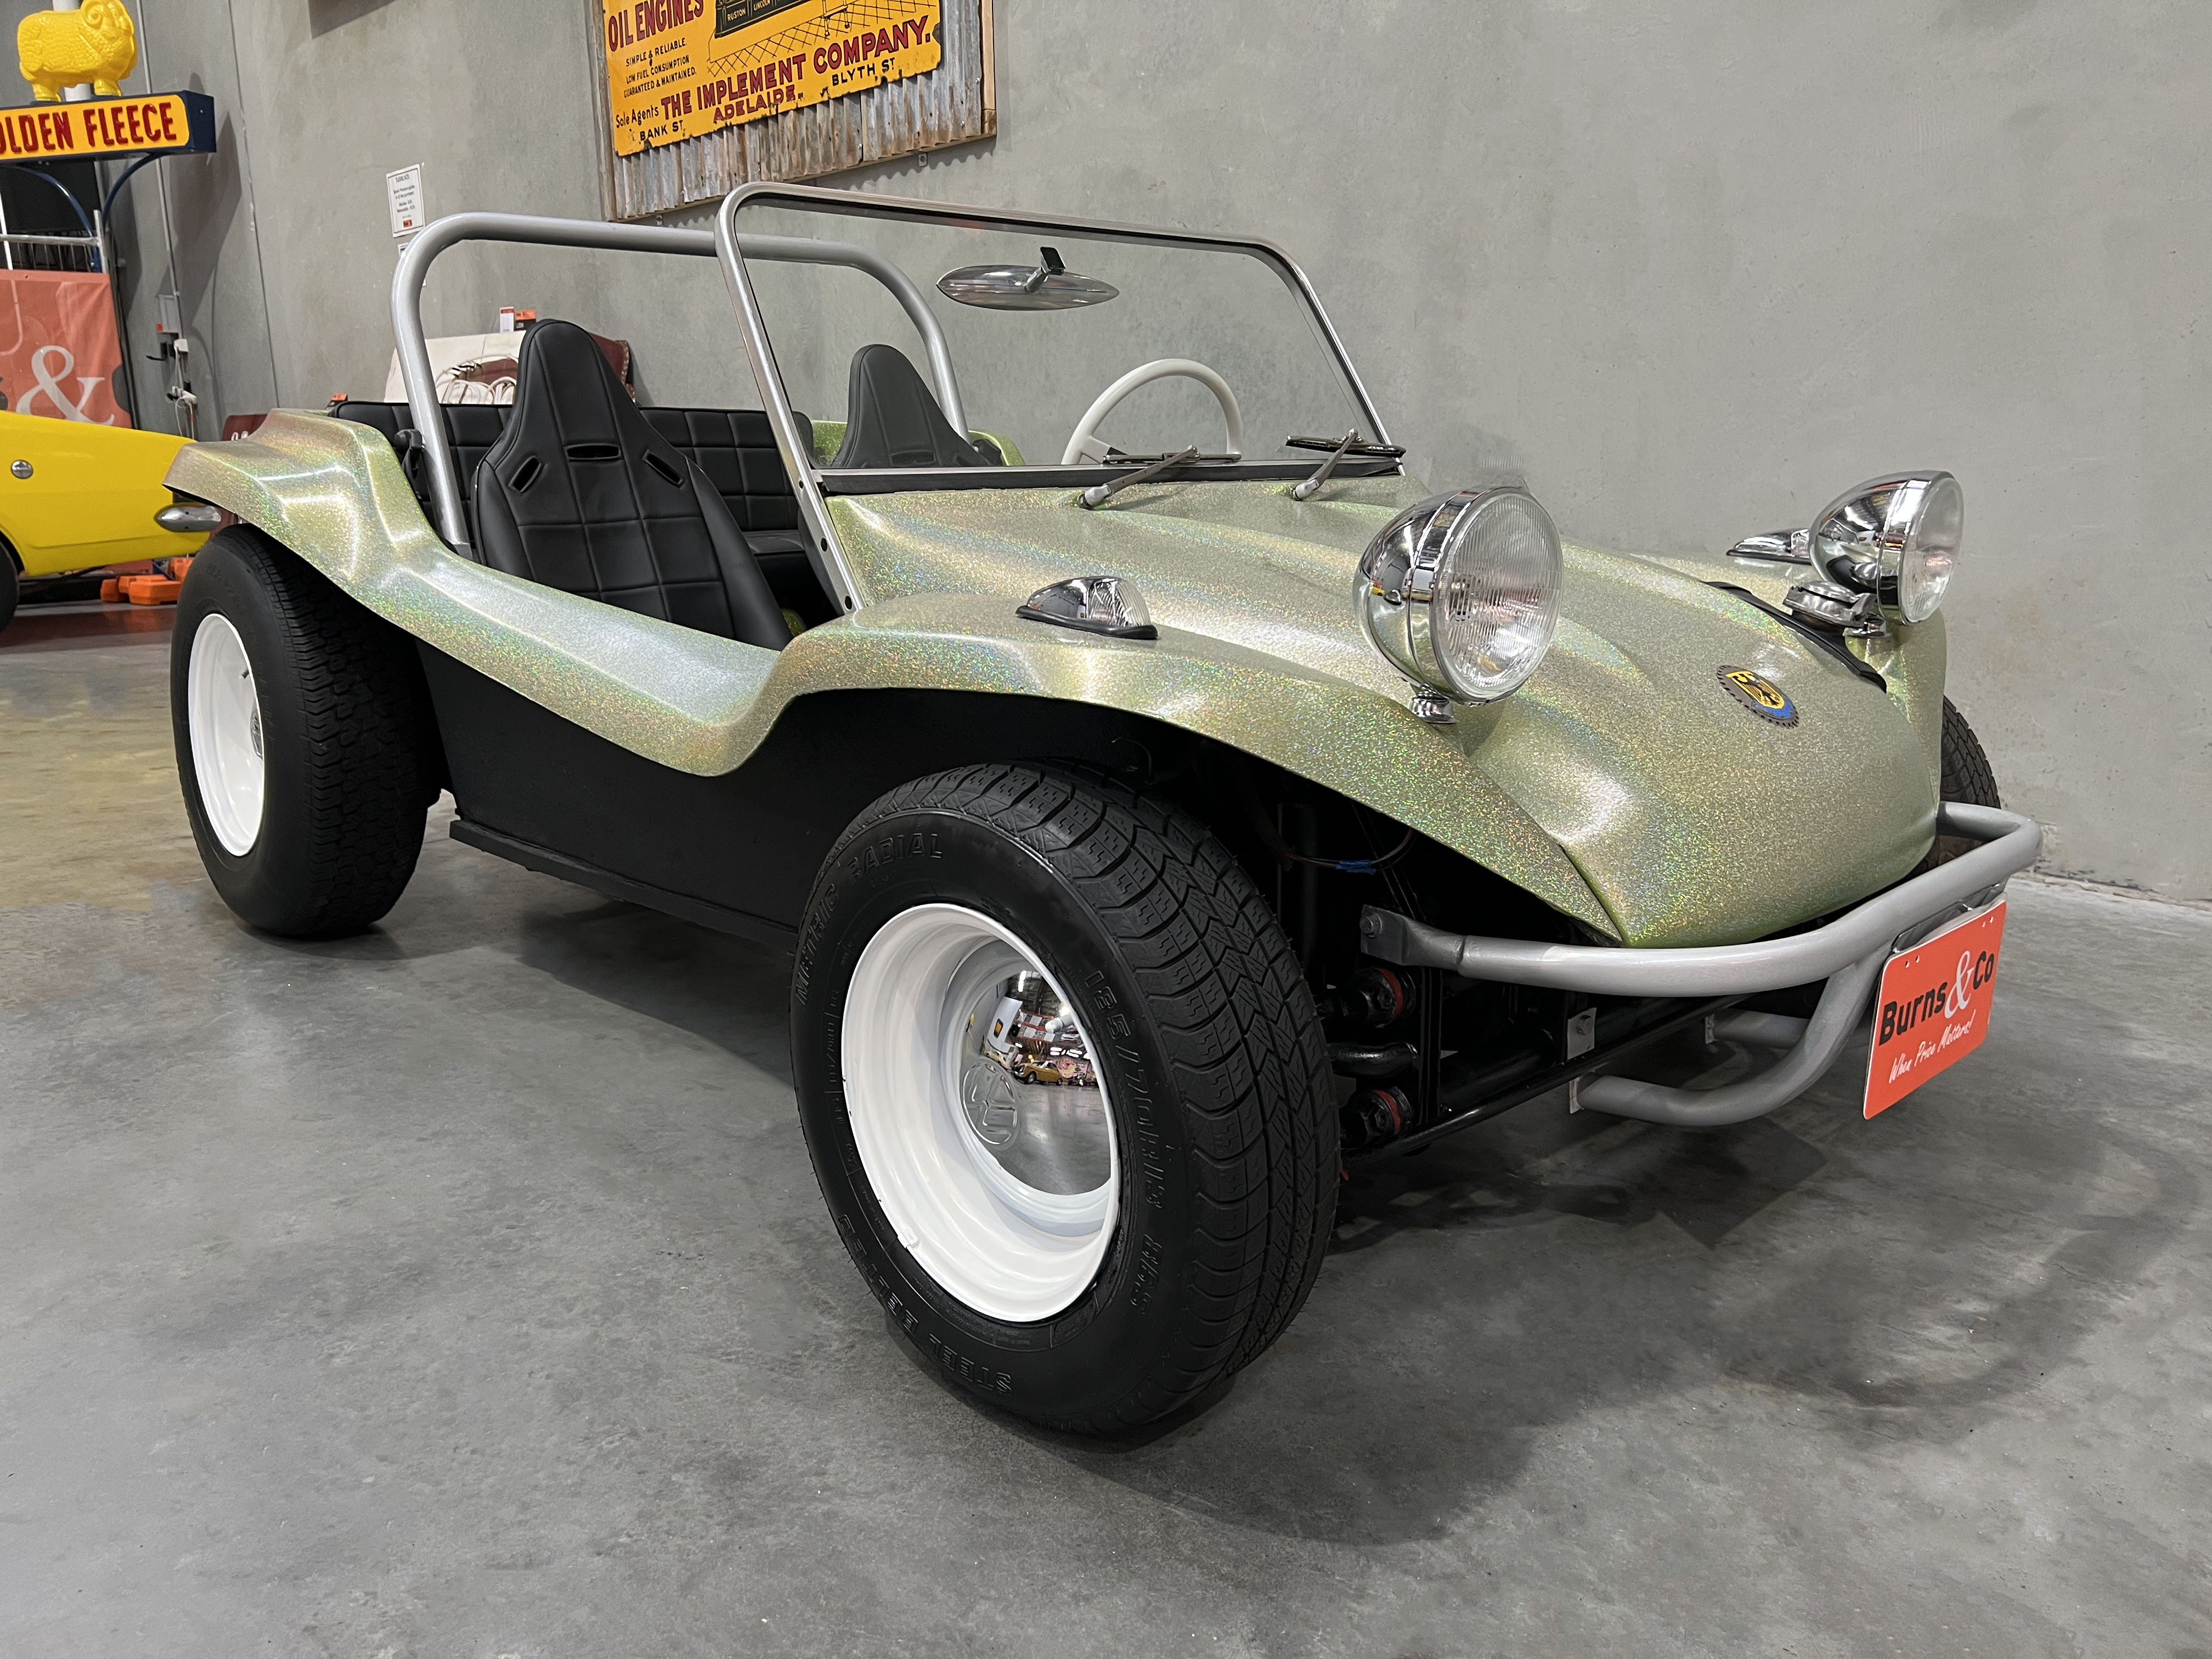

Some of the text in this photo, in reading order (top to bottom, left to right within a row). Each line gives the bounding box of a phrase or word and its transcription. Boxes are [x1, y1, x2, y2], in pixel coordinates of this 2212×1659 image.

[608, 9, 633, 52] OIL
[727, 8, 746, 21] RUSTON
[616, 15, 930, 128] Sole Agents THE IMPLEMENT COMPANY.
[626, 52, 646, 66] SIMPLE
[626, 55, 689, 84] LOW FUEL CONSUMPTION
[832, 63, 875, 86] BLYTH
[624, 81, 654, 98] GUARANTEED
[83, 102, 177, 146] FLEECE
[640, 125, 668, 141] BANK
[847, 833, 943, 884] RADIAL
[1889, 1009, 1976, 1084] When Price Matters!
[838, 1214, 918, 1335] BELTED
[929, 1334, 1013, 1394] STEEL
